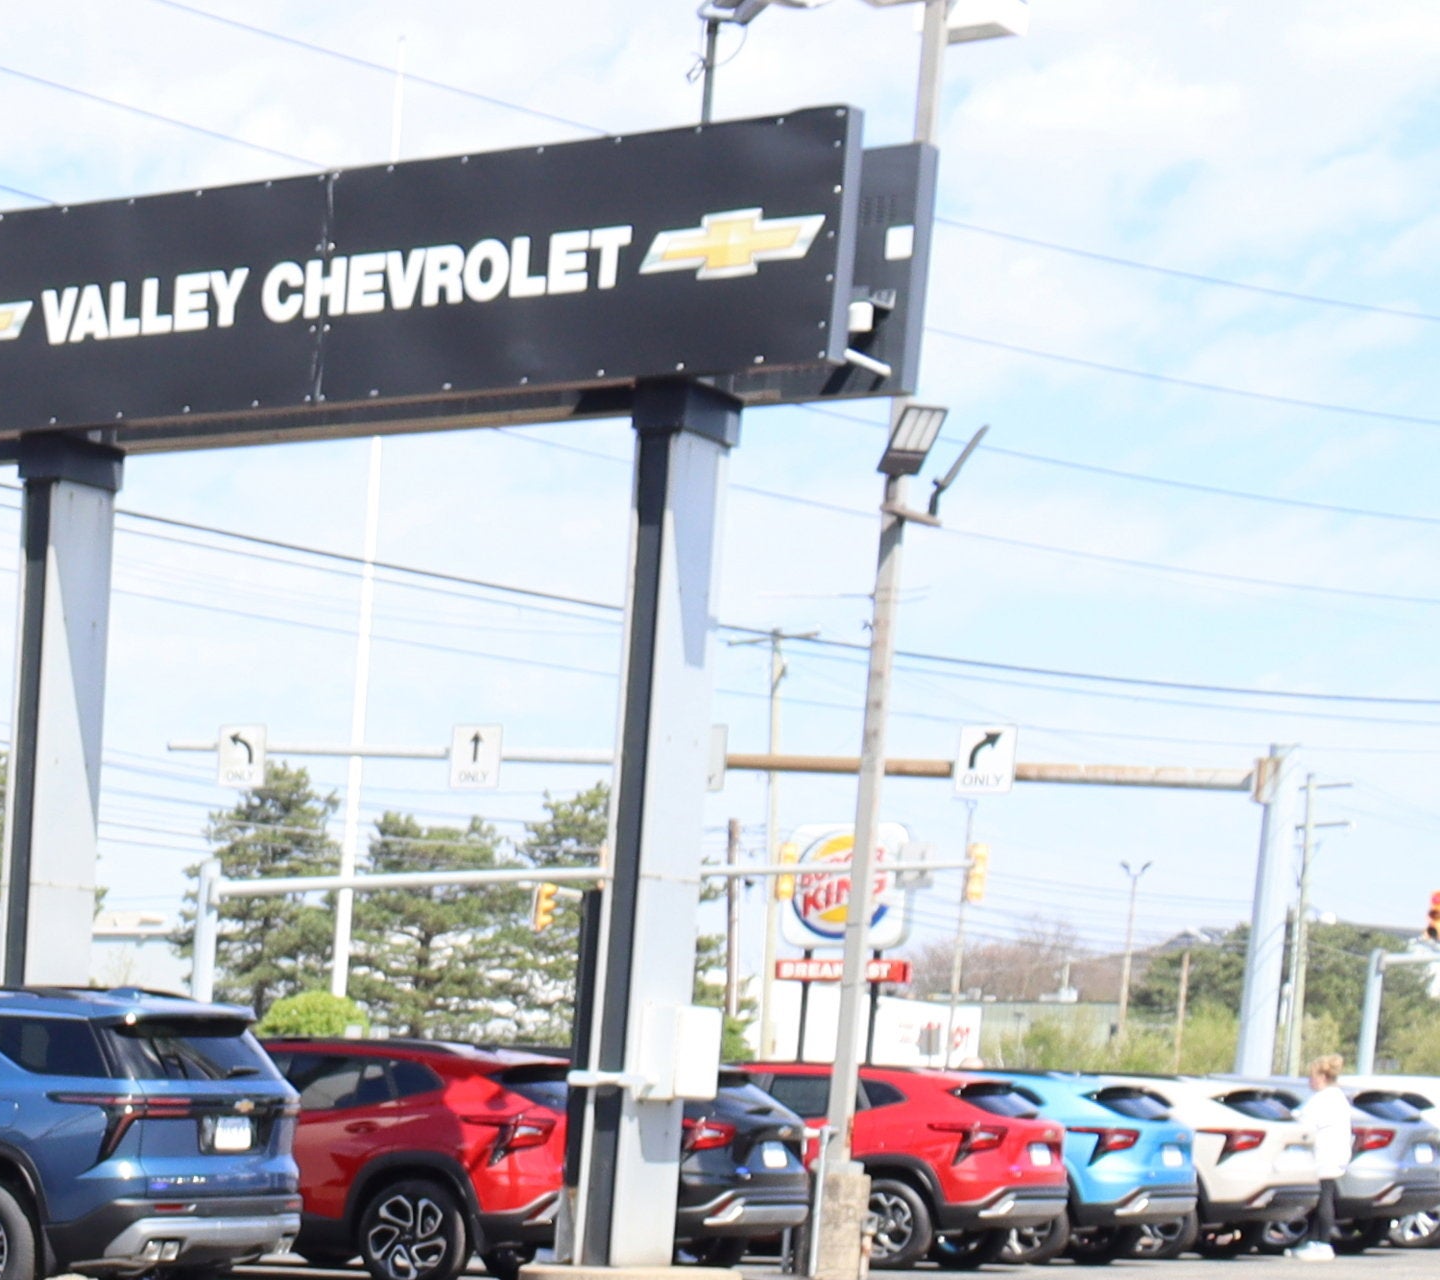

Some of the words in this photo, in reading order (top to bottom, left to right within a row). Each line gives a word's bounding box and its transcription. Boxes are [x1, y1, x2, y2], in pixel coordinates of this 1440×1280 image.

[41, 266, 250, 345] VALLEY
[261, 225, 632, 323] CHEVROLET
[961, 774, 1003, 787] ONLY
